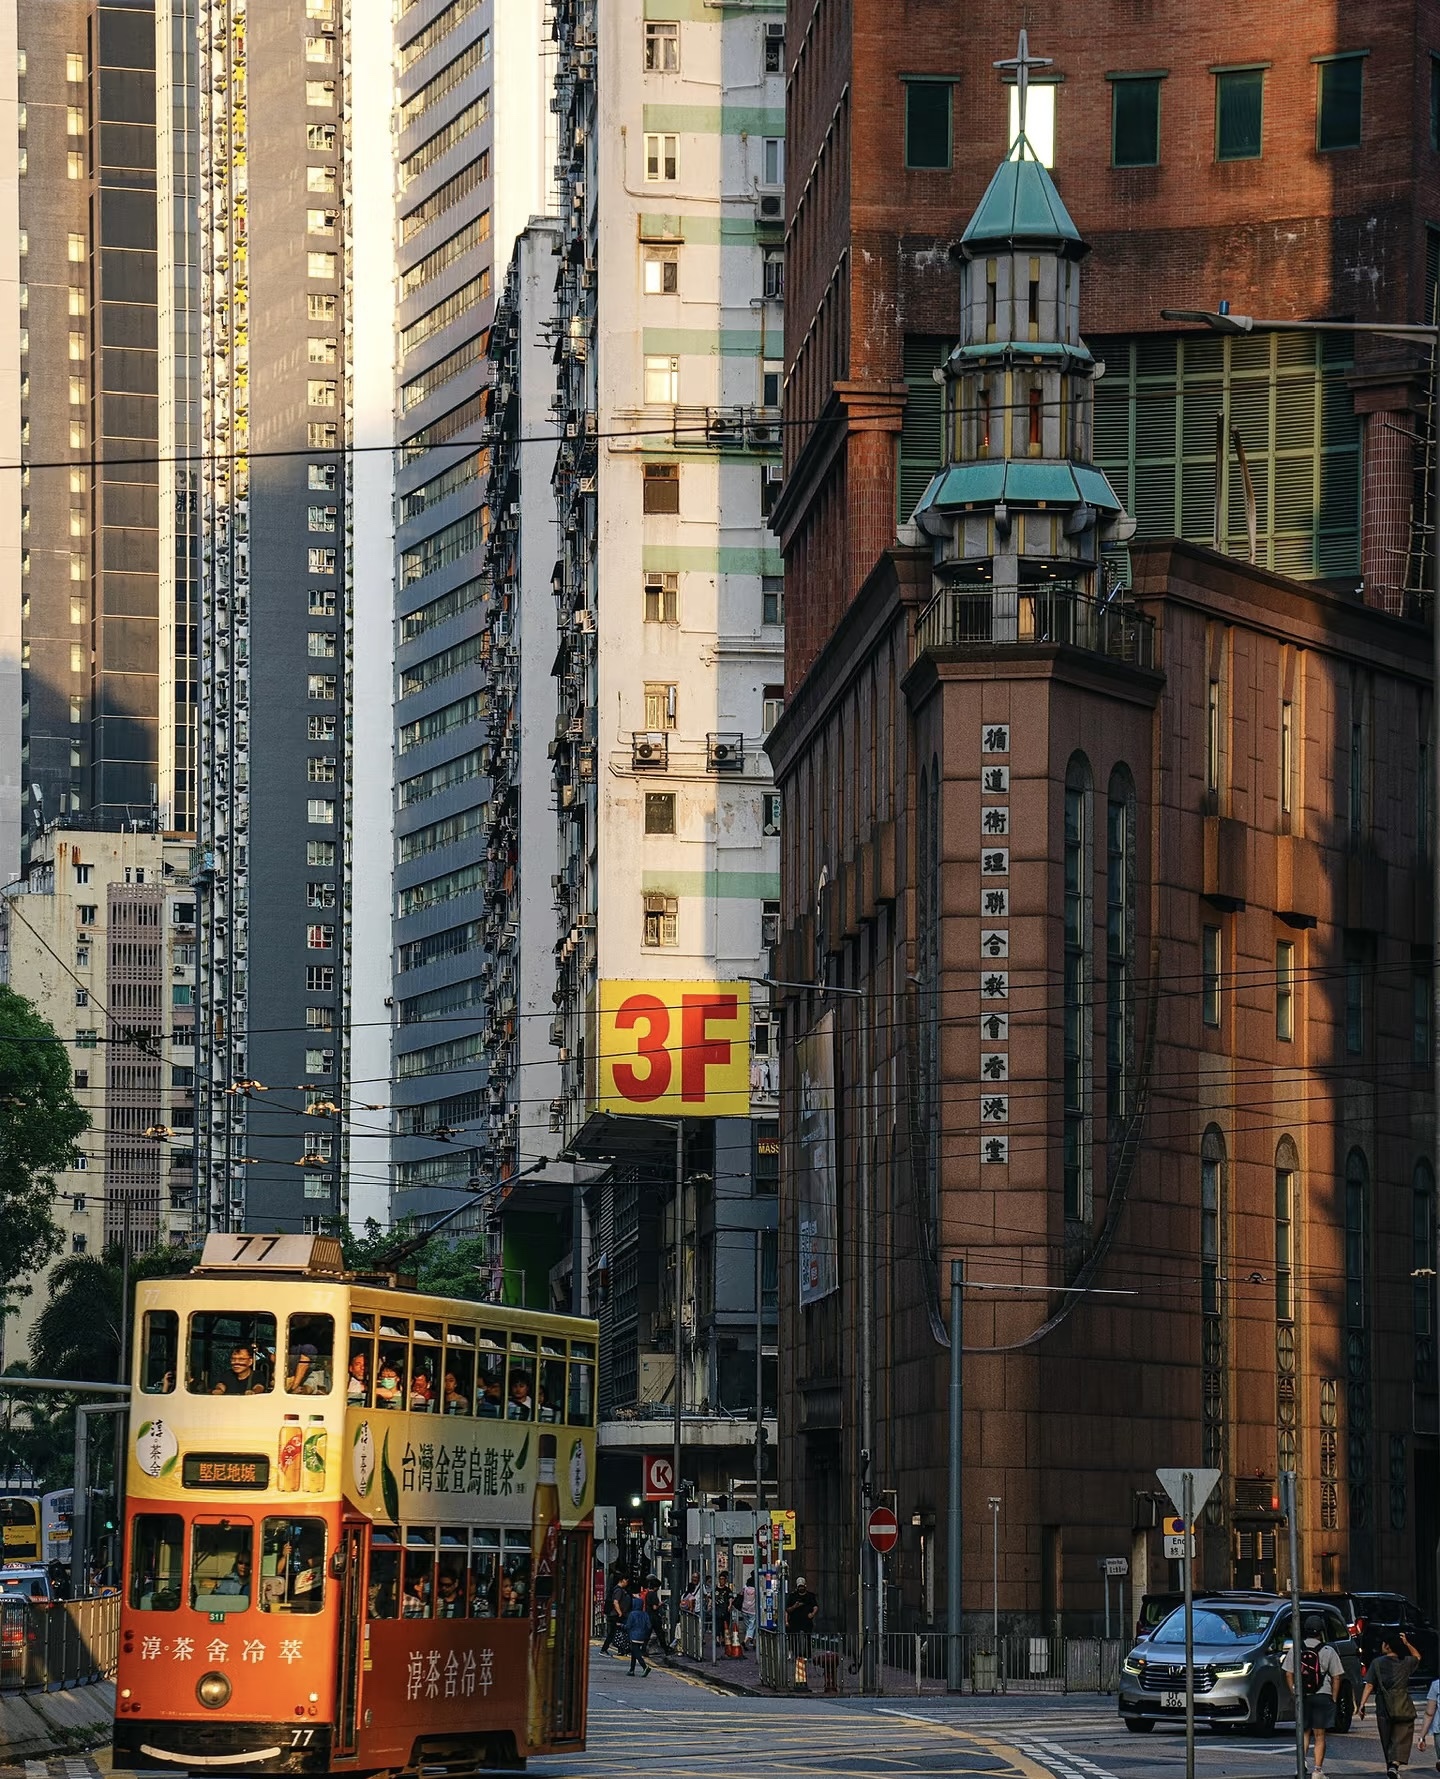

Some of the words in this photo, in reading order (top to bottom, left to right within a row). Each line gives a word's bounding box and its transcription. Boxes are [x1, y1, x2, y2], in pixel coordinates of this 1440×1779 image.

[611, 993, 738, 1103] 3F
[231, 1236, 281, 1262] 77
[144, 1289, 161, 1305] 77
[199, 1463, 256, 1482] 堅尼地城
[402, 1442, 515, 1496] 台灣金萱烏龍茶
[655, 1465, 672, 1487] K
[290, 1729, 315, 1746] 77
